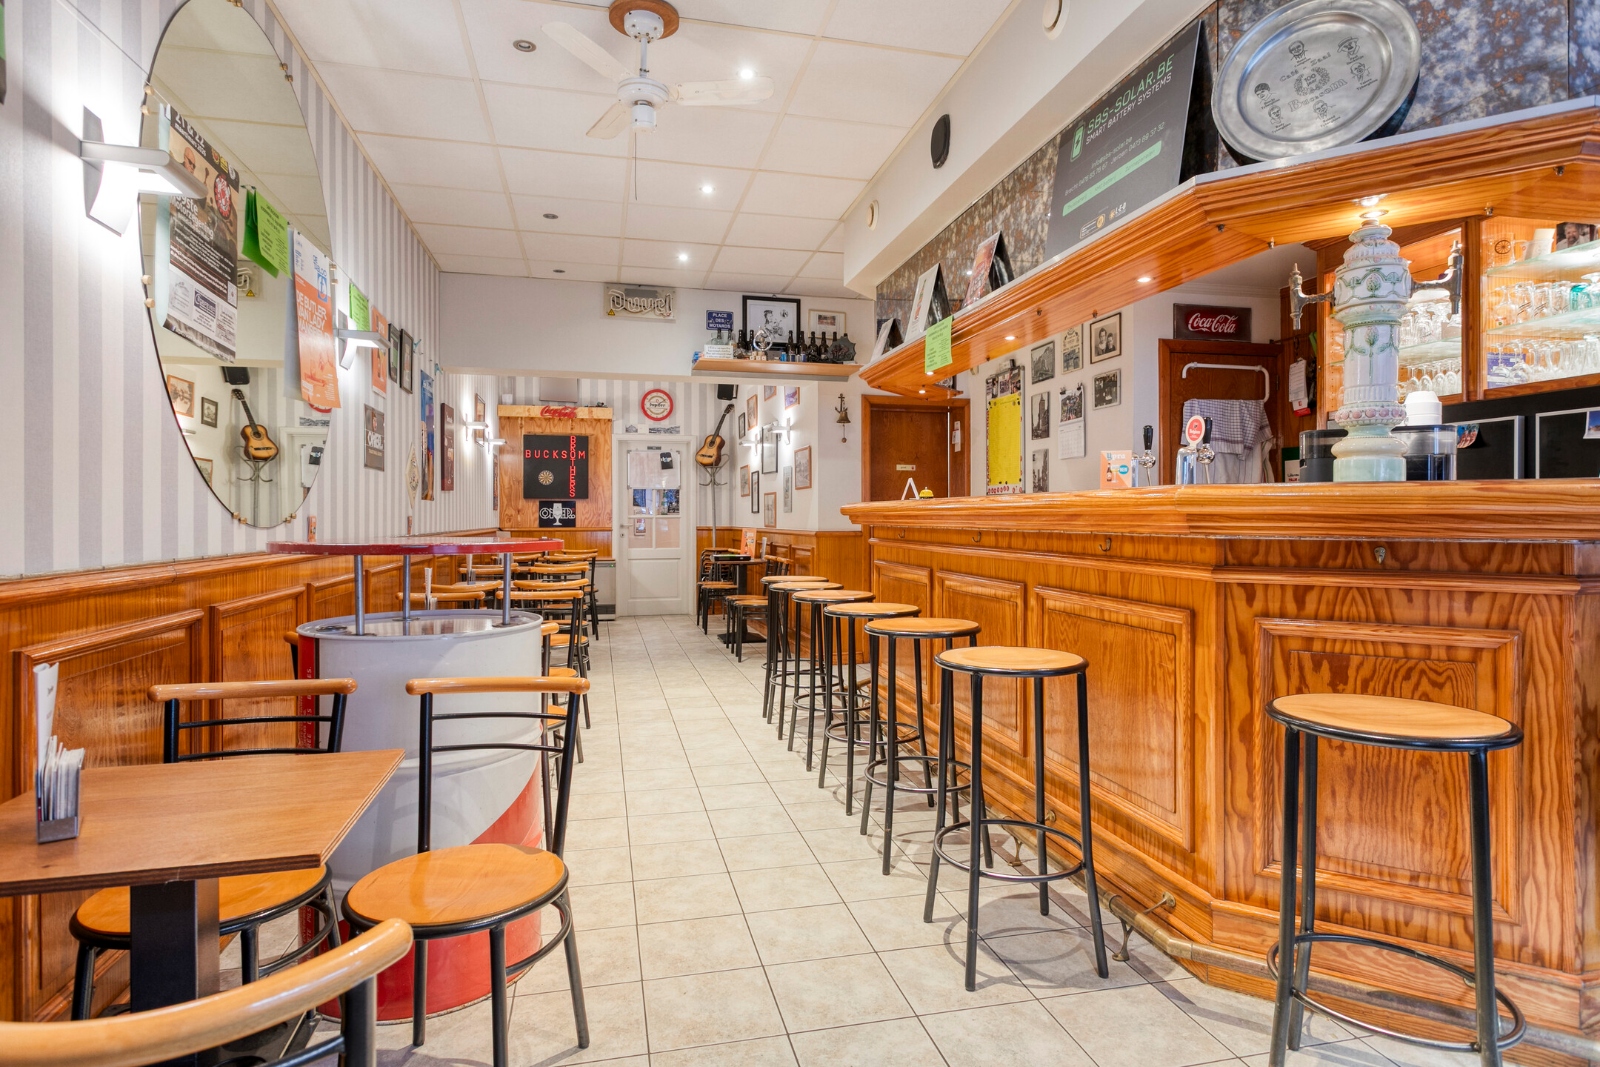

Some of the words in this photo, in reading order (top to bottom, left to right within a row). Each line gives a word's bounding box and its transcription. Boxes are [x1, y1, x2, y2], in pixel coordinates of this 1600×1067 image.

[1303, 73, 1317, 83] 100
[1086, 122, 1106, 145] SMART
[1107, 101, 1136, 128] BATTERY
[1137, 72, 1172, 105] SYSTEMS
[1087, 54, 1174, 134] SBS-SOLAR.BE
[304, 295, 328, 321] BUTLER
[608, 289, 674, 318] Duvel
[308, 312, 326, 331] LADY
[569, 435, 577, 498] BROTHERS
